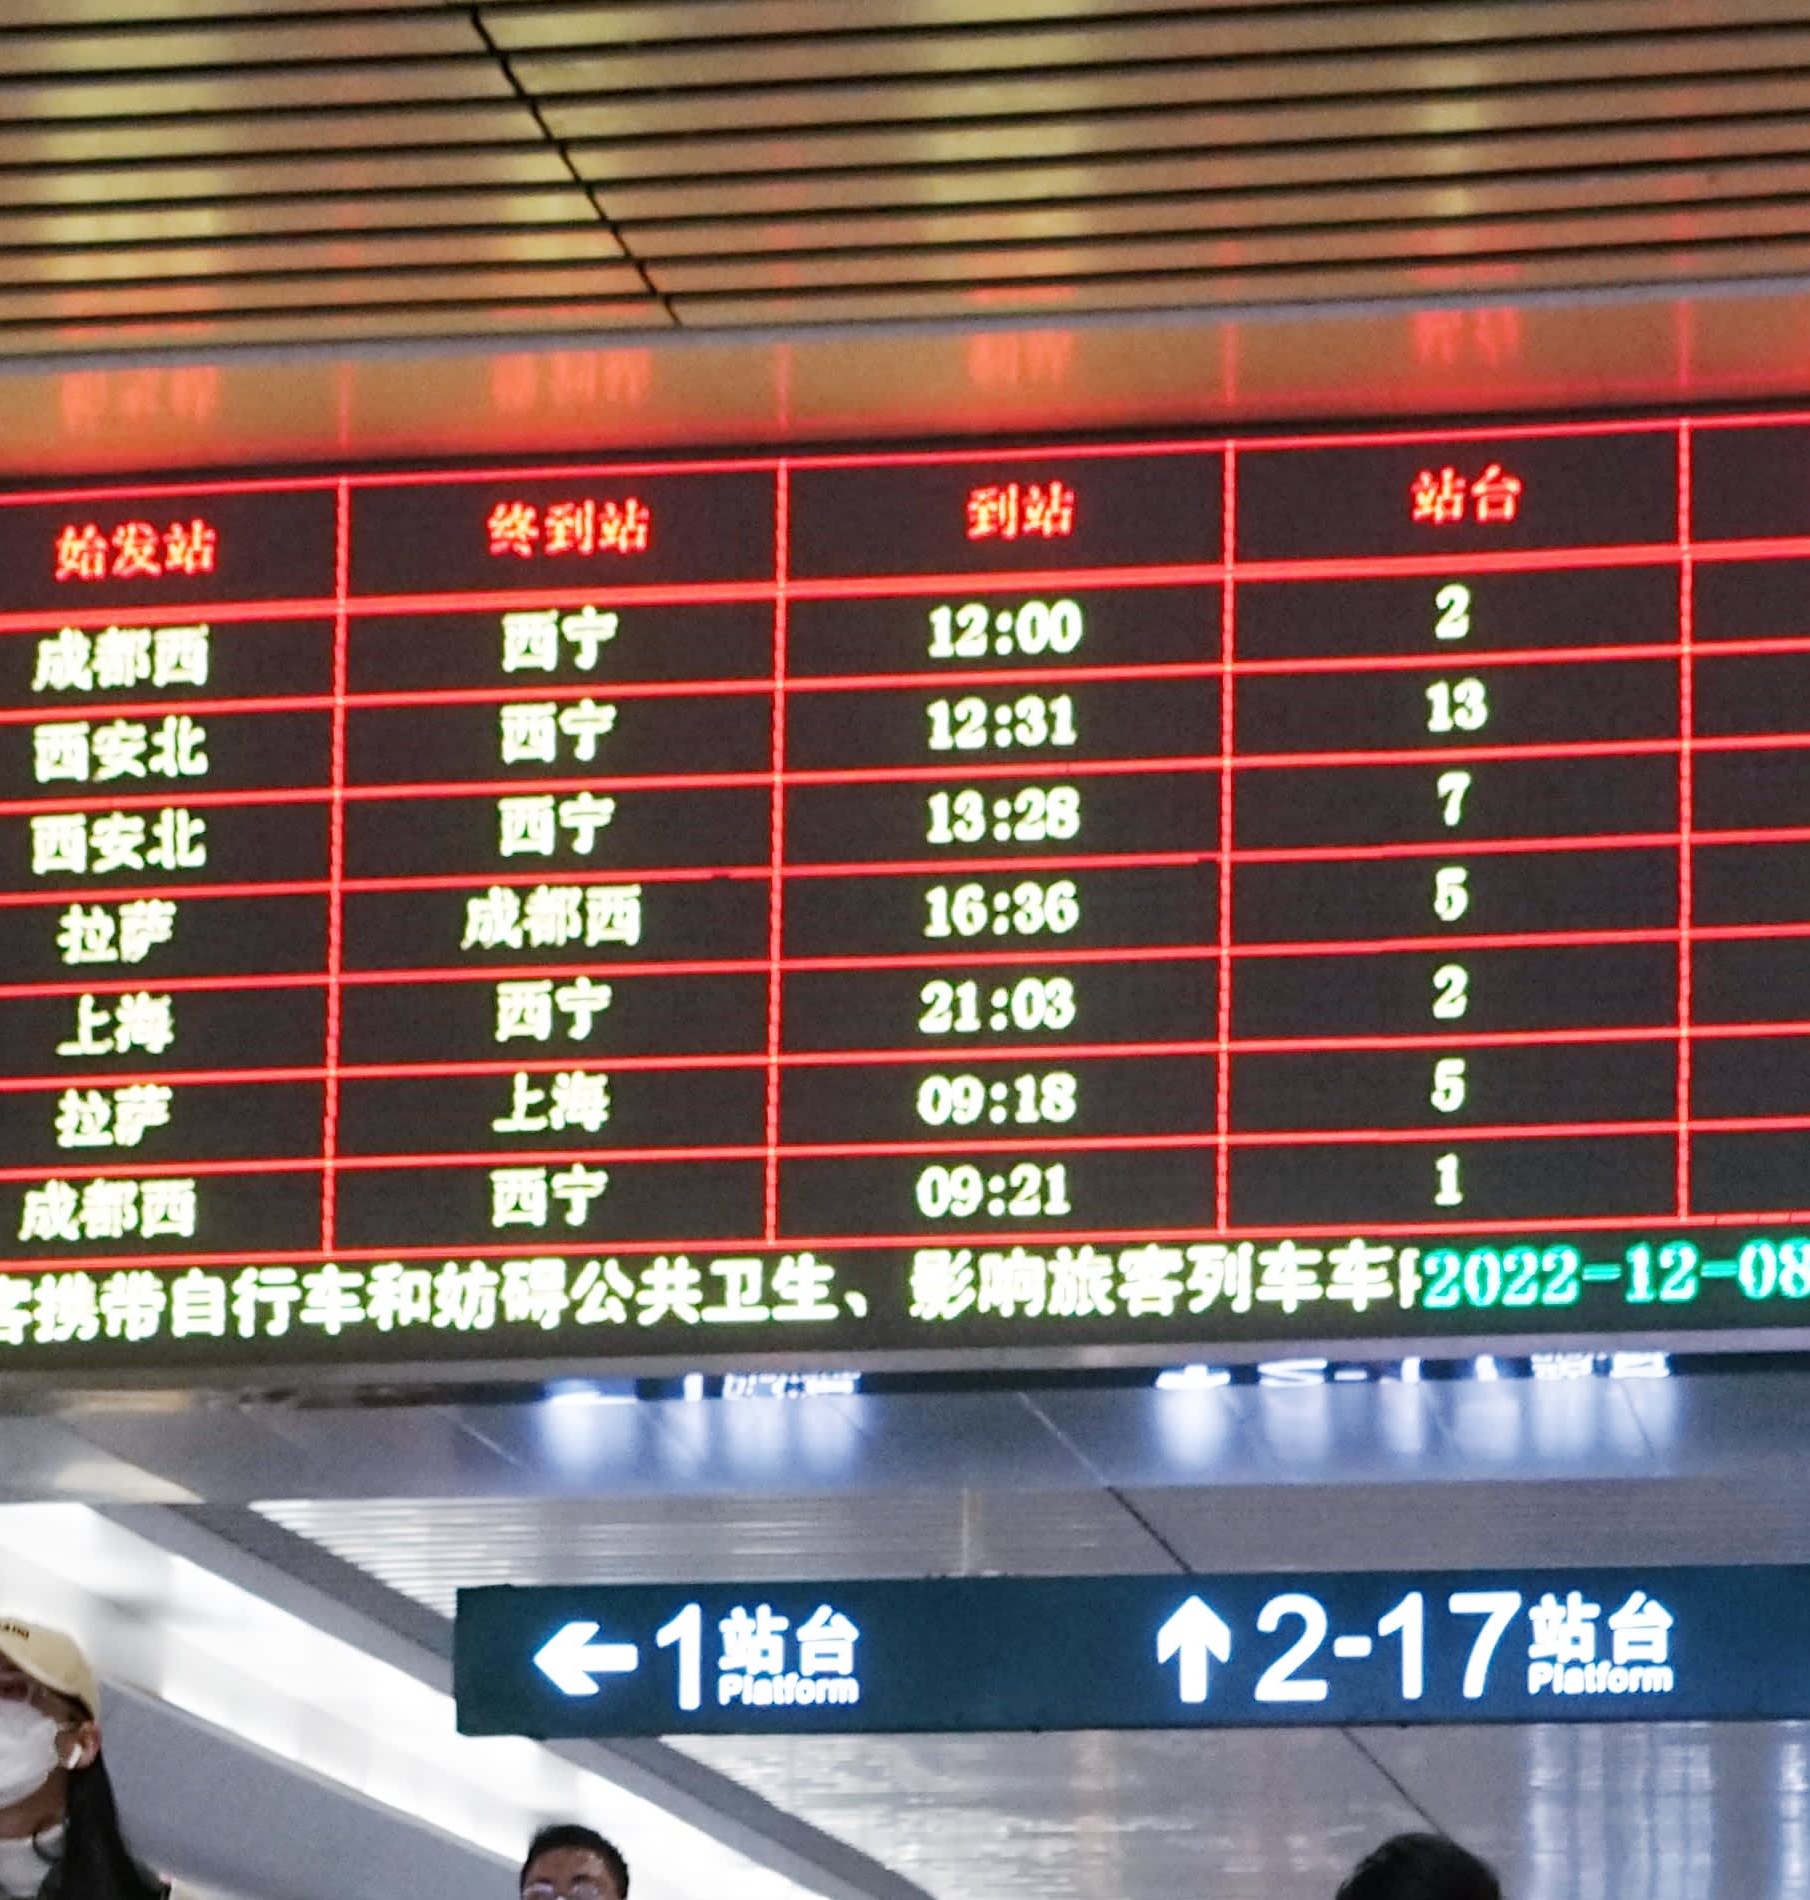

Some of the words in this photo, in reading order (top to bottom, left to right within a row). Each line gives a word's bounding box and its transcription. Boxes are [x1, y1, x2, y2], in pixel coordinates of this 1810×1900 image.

[53, 517, 218, 583] 始发站
[486, 495, 652, 560] 终到站
[965, 479, 1076, 542] 到站
[1409, 463, 1523, 527] 站台
[32, 624, 209, 692] 成都西
[502, 605, 619, 673] 西宁
[928, 599, 1083, 658] 12:00
[1435, 584, 1470, 640] 2
[33, 715, 209, 783] 西安北
[500, 699, 617, 764] 西宁
[927, 694, 1077, 750] 12:31
[1426, 677, 1488, 732] 13
[30, 808, 207, 875] 西安北
[497, 792, 616, 857] 西宁
[926, 785, 1081, 844] 13:28
[1437, 771, 1471, 826] 7
[56, 899, 177, 965] 拉萨
[460, 884, 642, 950] 成都西
[924, 879, 1080, 938] 16:36
[1433, 866, 1469, 921] 5
[56, 991, 175, 1056] 上海
[495, 976, 612, 1043] 西宁
[918, 977, 1077, 1034] 21:03
[1433, 964, 1469, 1019] 2
[54, 1084, 173, 1148] 拉萨
[492, 1071, 610, 1133] 上海
[916, 1071, 1077, 1126] 09:18
[1430, 1058, 1466, 1113] 5
[18, 1178, 197, 1242] 成都西
[489, 1163, 609, 1228] 西宁
[915, 1163, 1072, 1218] 09:21
[1434, 1153, 1463, 1206] 1
[655, 1603, 702, 1711] 1
[717, 1603, 860, 1675] 站台
[1527, 1590, 1674, 1664] 站台
[717, 1673, 860, 1706] Platform
[1527, 1661, 1674, 1695] Platform
